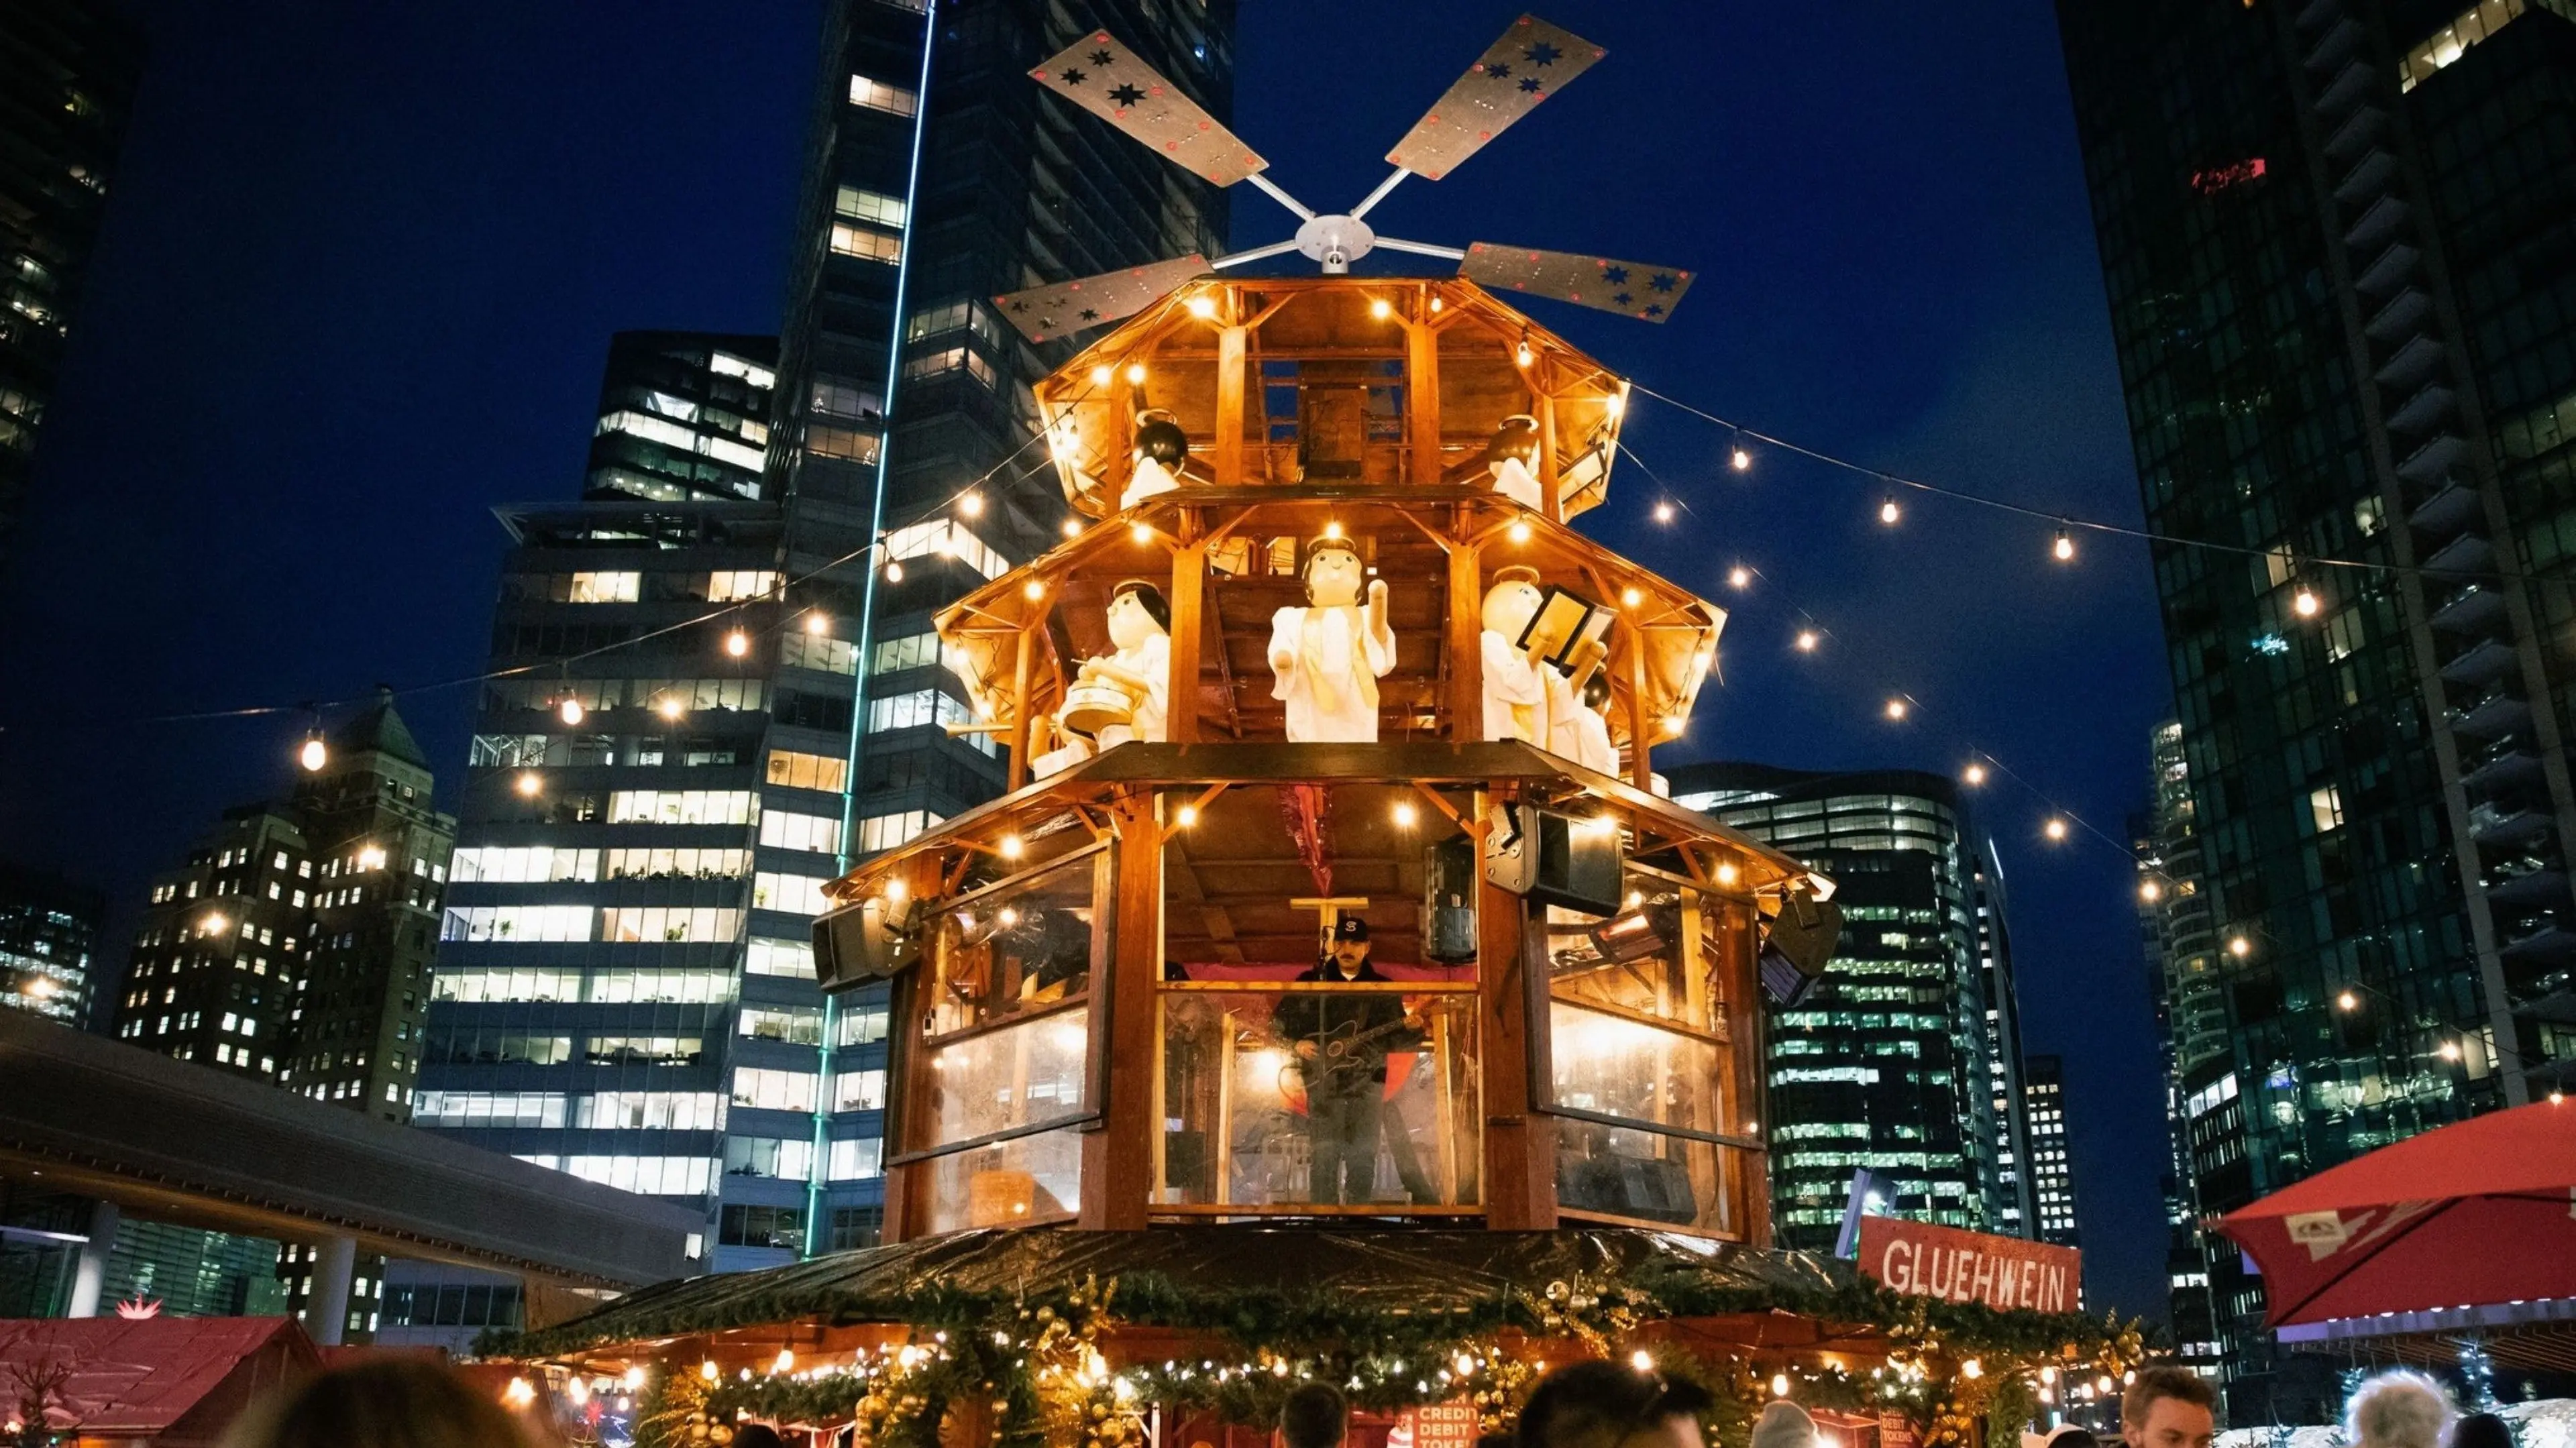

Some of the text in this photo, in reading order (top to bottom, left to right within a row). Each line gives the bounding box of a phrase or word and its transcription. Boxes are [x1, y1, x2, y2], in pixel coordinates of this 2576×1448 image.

[1345, 921, 1357, 932] S
[1882, 1239, 2065, 1312] GLUEHWEIN
[1419, 1407, 1478, 1421] CREDIT
[1419, 1423, 1470, 1436] DEBIT
[1419, 1439, 1470, 1448] TOKE
